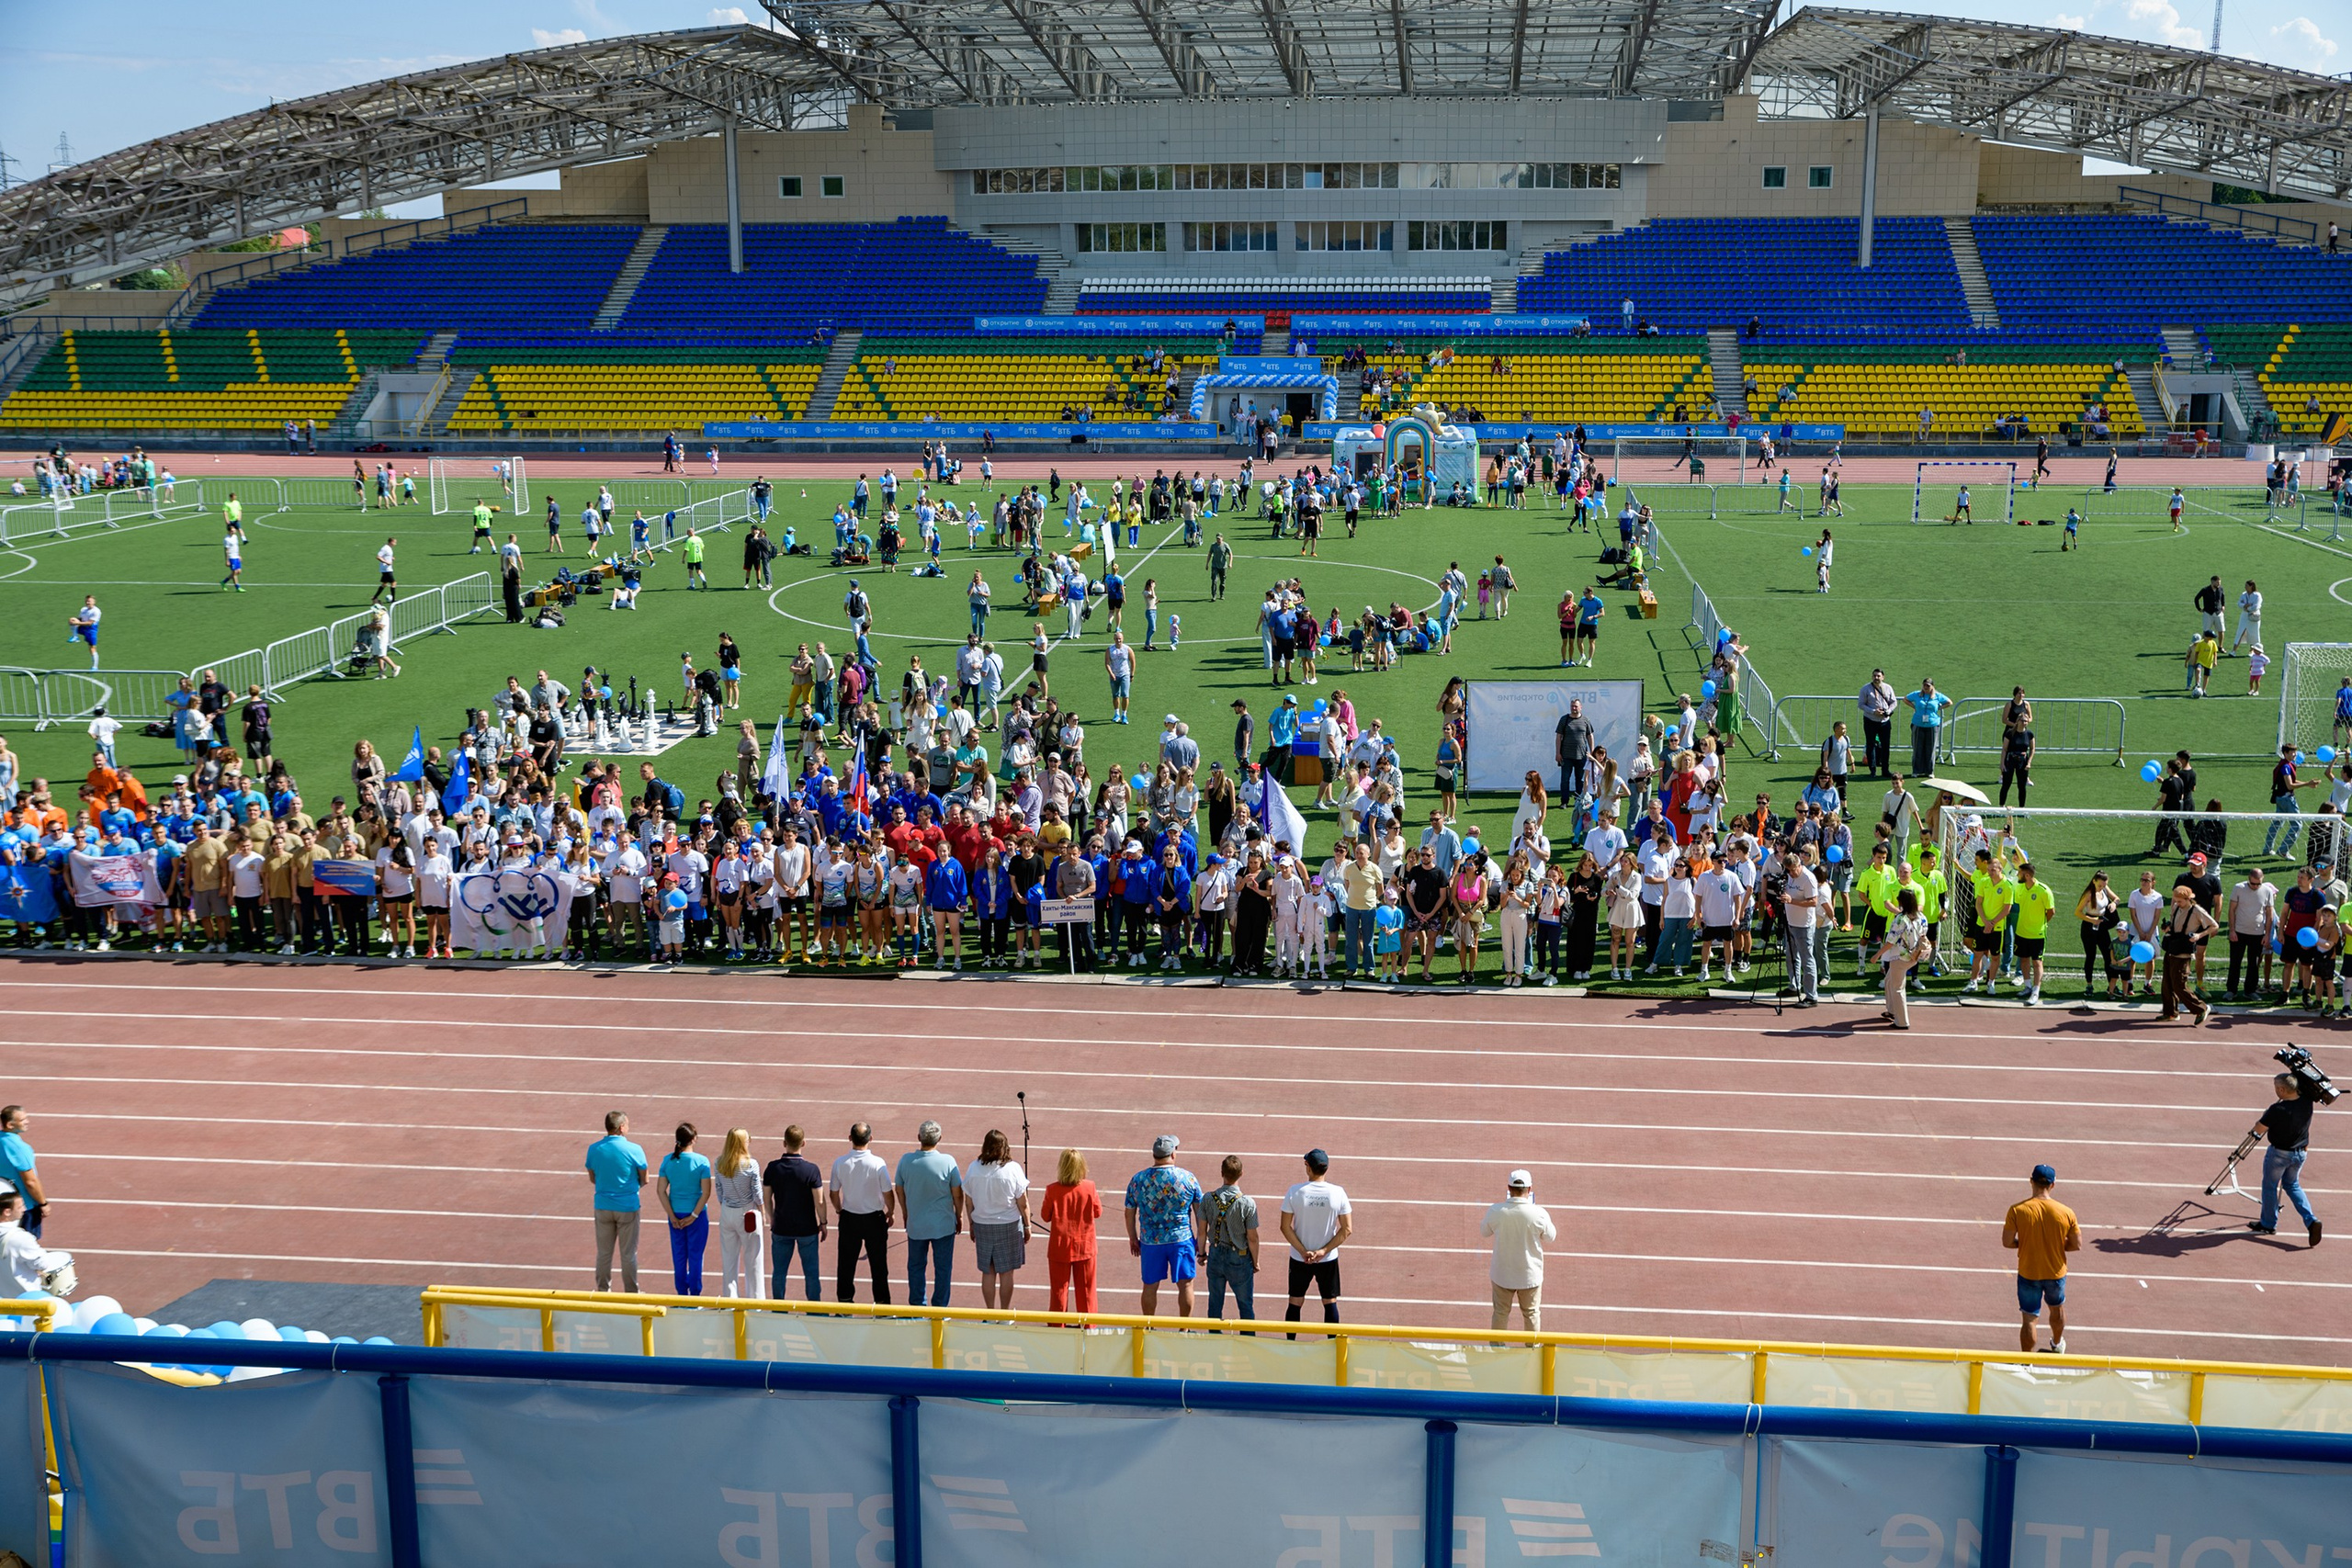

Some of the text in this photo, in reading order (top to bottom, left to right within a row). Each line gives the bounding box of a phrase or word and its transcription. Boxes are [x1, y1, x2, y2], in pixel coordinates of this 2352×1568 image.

[1127, 427, 1140, 435] ВТБ
[1161, 427, 1174, 435] ВТБ
[1194, 427, 1208, 435] ВТБ
[1661, 428, 1676, 436] ВТБ
